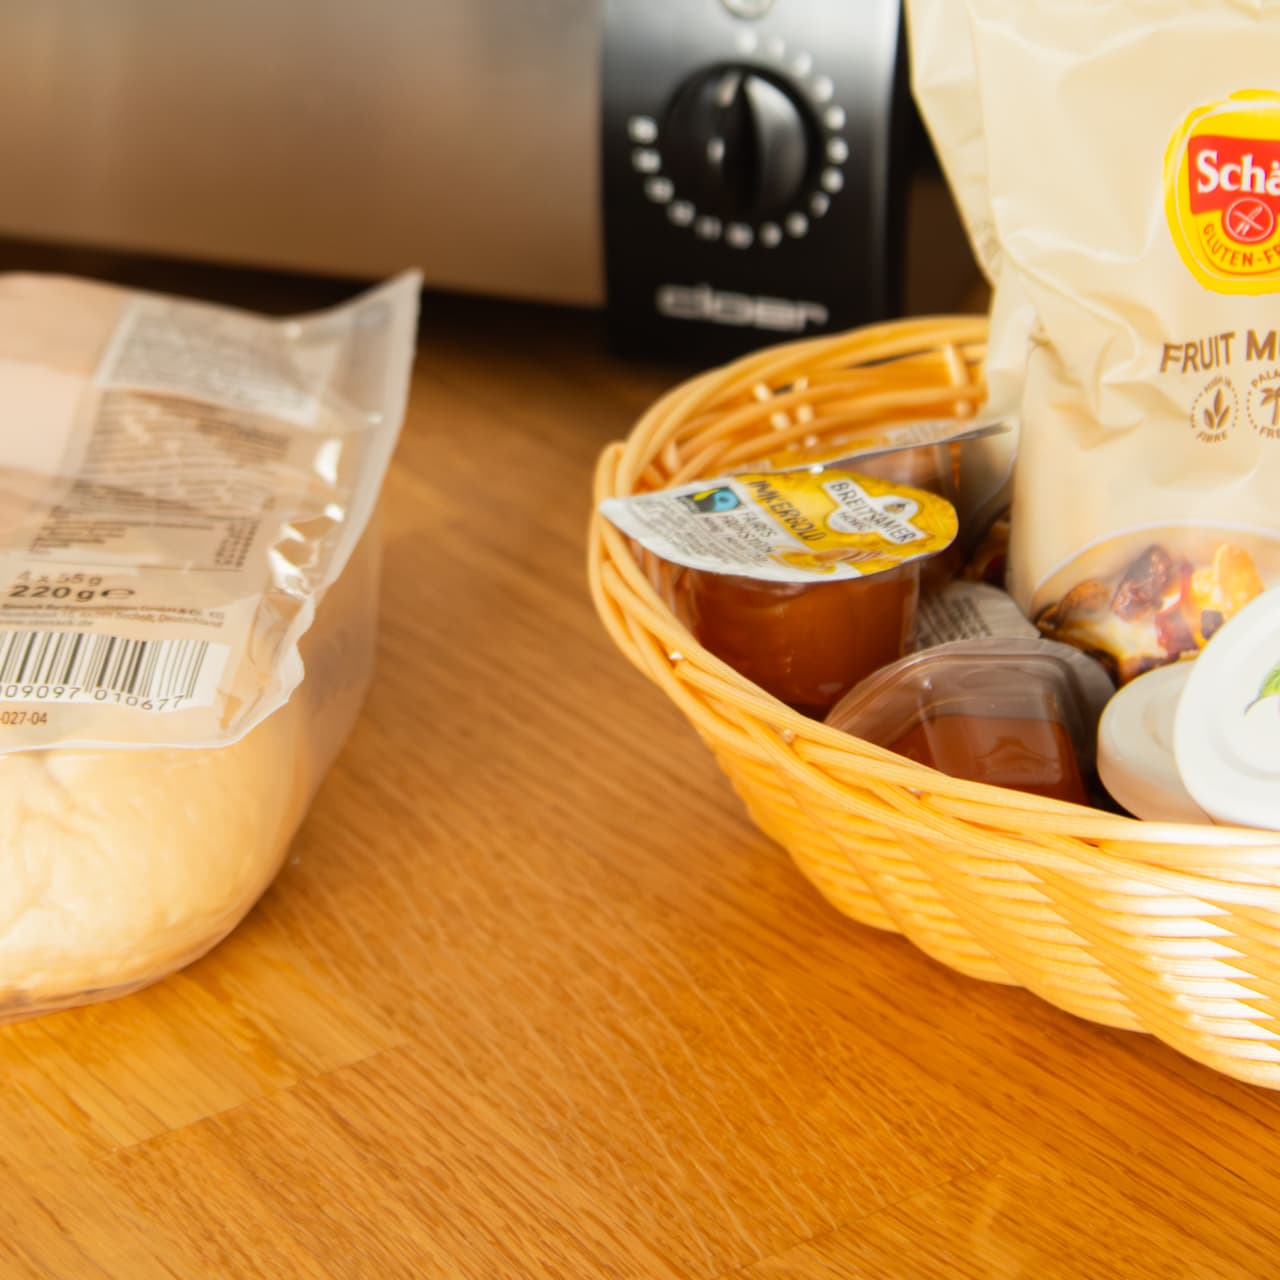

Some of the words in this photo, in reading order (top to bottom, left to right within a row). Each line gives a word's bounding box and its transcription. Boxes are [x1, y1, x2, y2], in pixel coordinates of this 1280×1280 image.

[1160, 331, 1236, 374] FRUIT
[829, 480, 917, 543] BREITSAMER
[9, 585, 71, 600] 220
[76, 588, 95, 602] g
[94, 688, 185, 712] 010677
